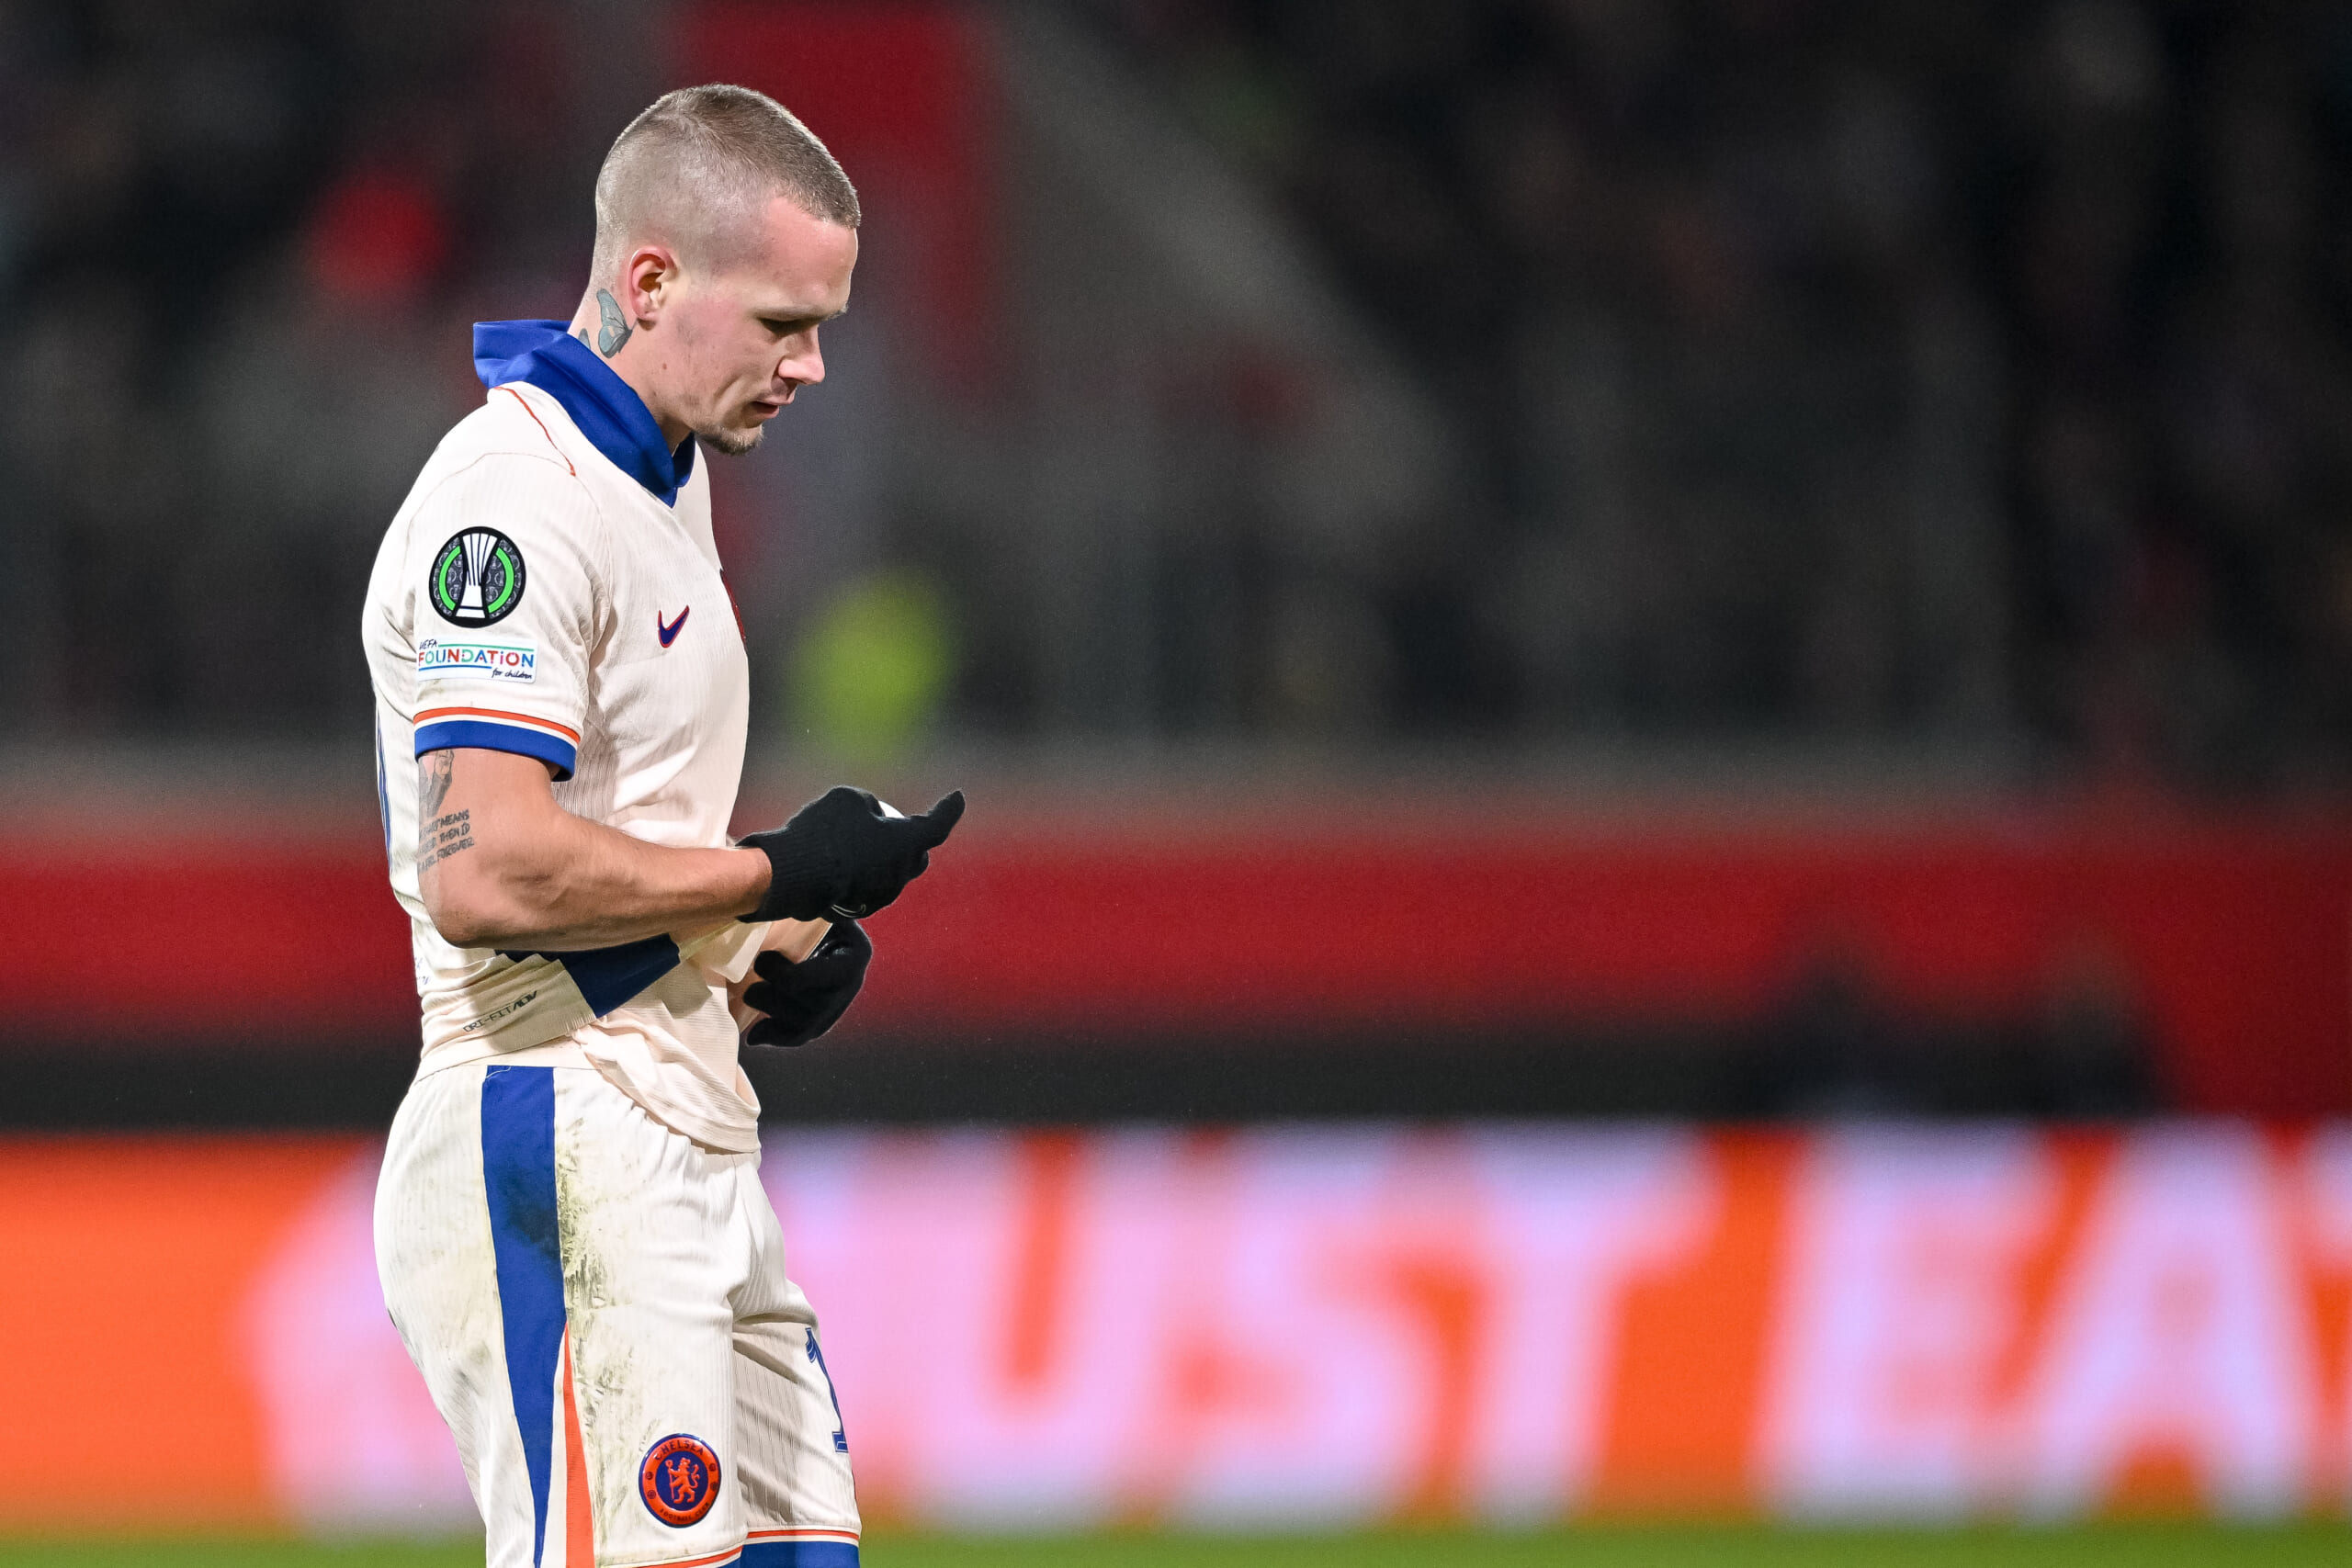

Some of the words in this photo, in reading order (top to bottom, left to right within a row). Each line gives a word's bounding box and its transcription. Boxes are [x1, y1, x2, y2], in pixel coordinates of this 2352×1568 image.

[419, 638, 437, 650] UEFA
[492, 668, 503, 678] for
[504, 669, 533, 680] children
[436, 837, 475, 862] FOREVER
[654, 1439, 705, 1461] CHELSEA
